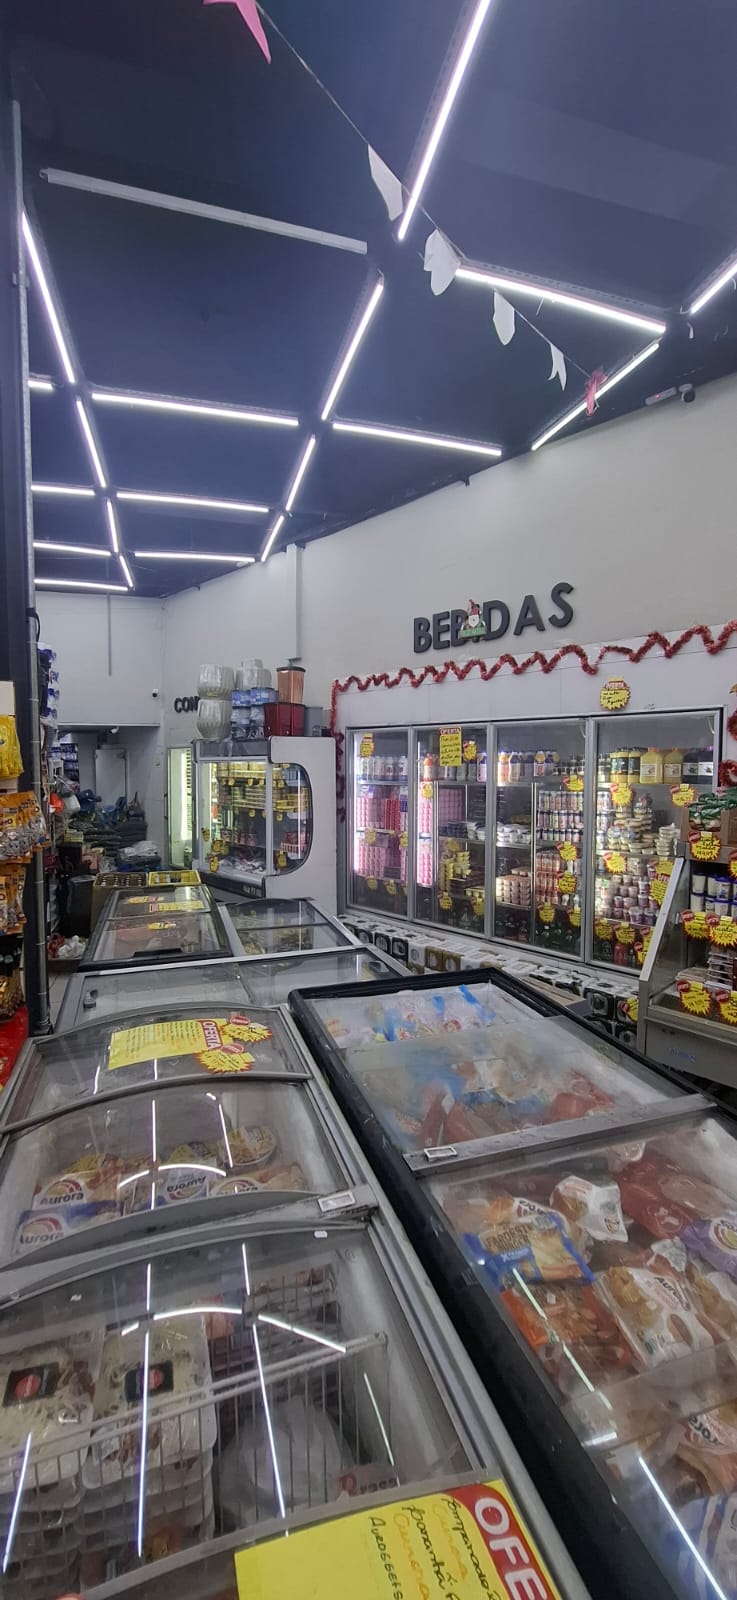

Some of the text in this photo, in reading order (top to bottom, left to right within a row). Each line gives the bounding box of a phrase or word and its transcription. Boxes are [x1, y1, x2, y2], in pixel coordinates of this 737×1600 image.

[413, 582, 575, 654] BEBDAS
[203, 1021, 220, 1050] OFERTA
[167, 1176, 206, 1193] Aurora
